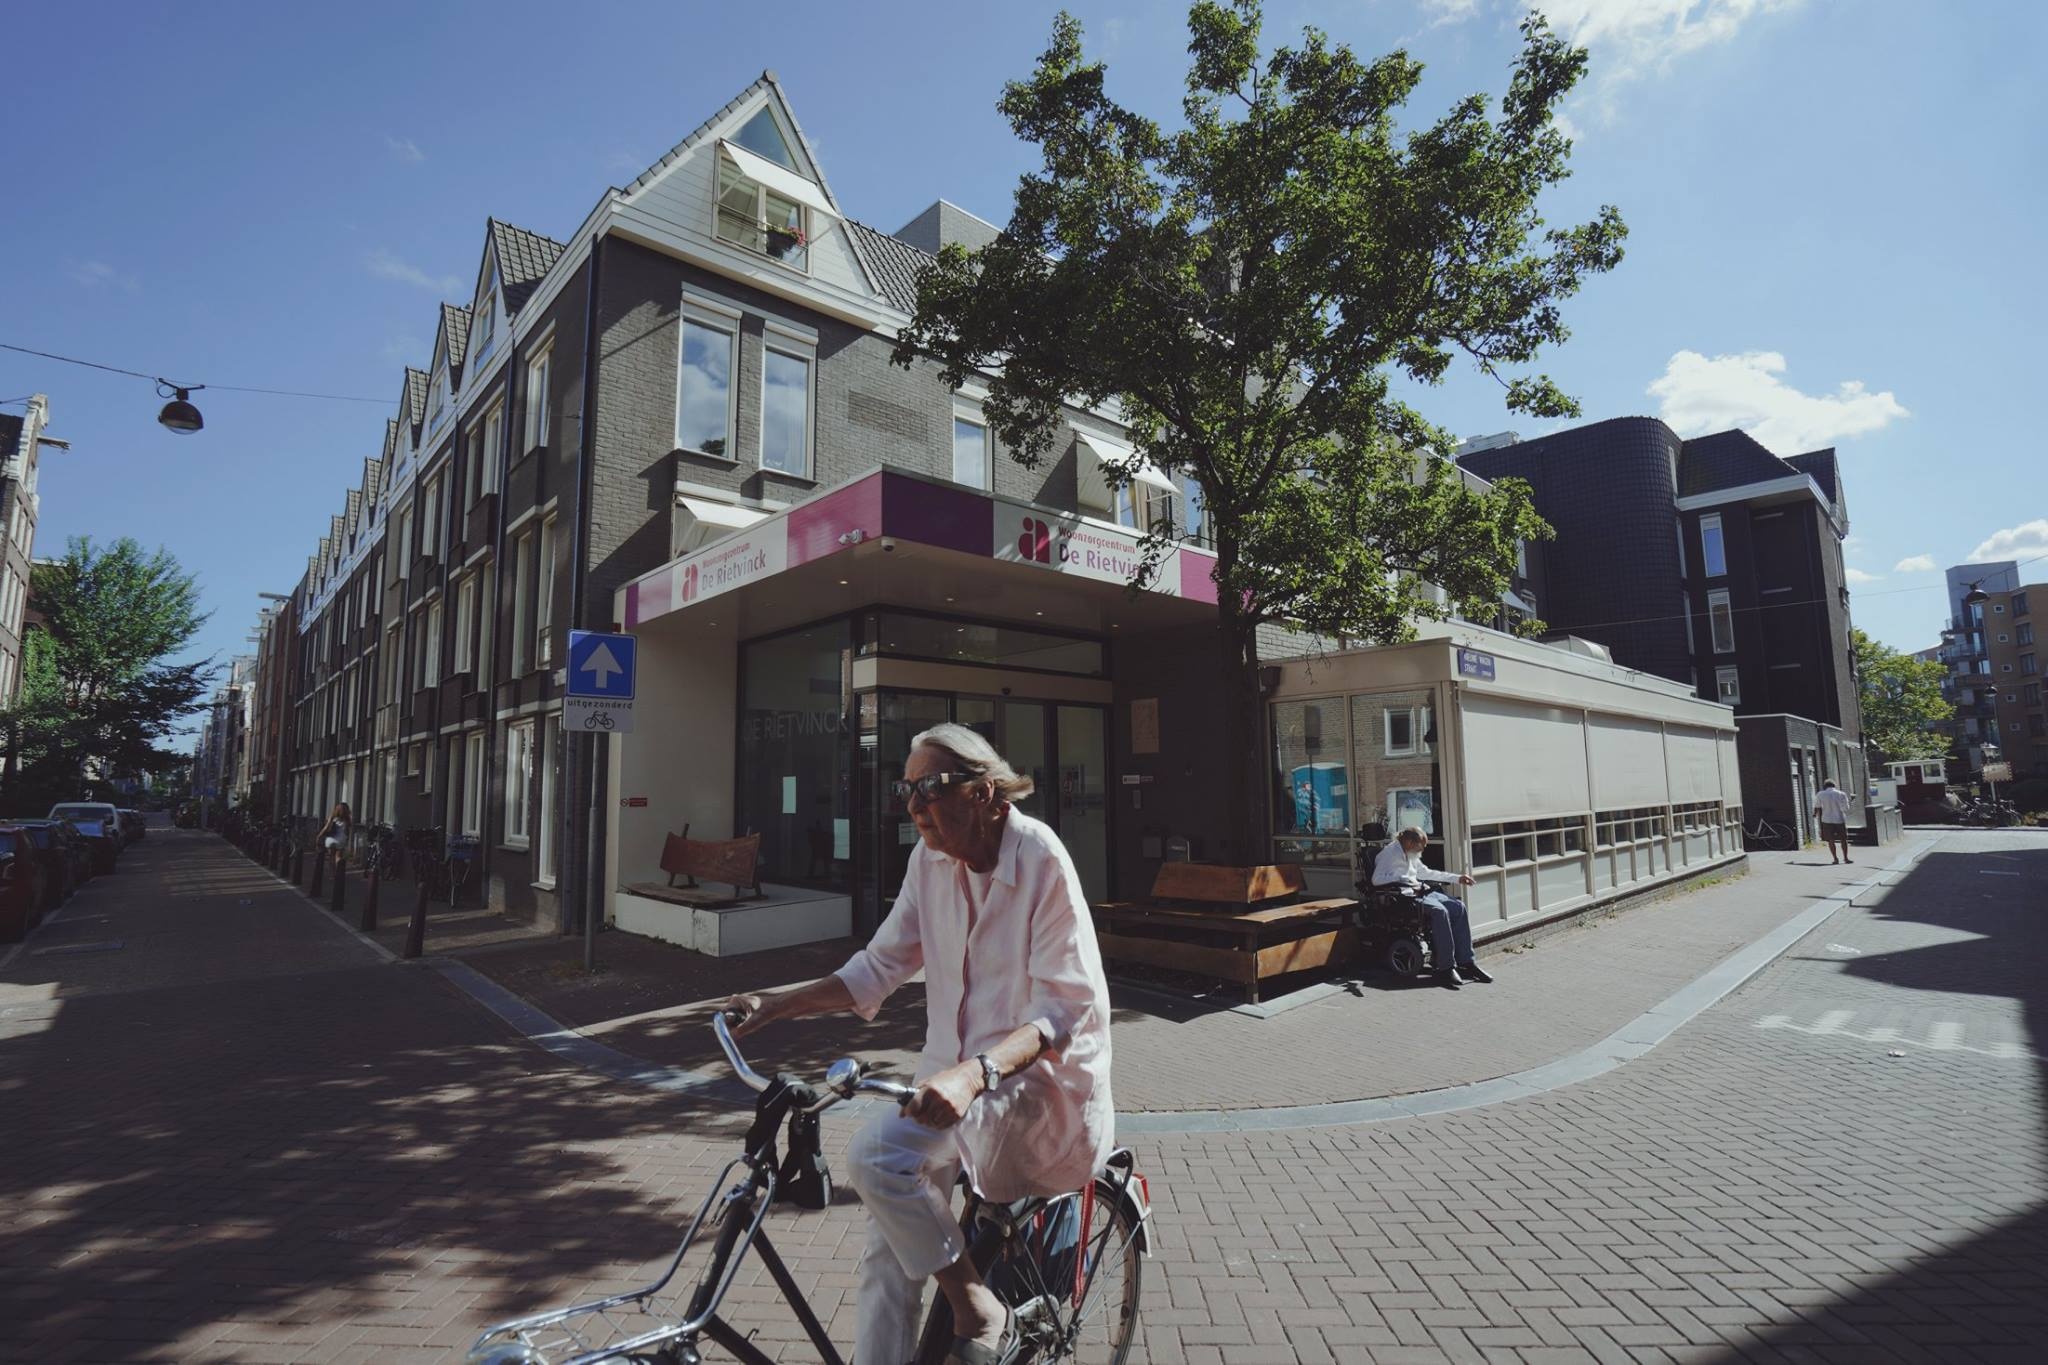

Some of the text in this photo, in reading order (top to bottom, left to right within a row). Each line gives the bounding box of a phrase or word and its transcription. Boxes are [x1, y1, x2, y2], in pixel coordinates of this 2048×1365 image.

[1058, 526, 1136, 555] Woonzorgcentrum
[1059, 543, 1080, 565] De
[702, 548, 766, 591] De Rietvinck
[567, 700, 633, 710] uitgezonderd
[764, 708, 848, 739] RIETVINCK
